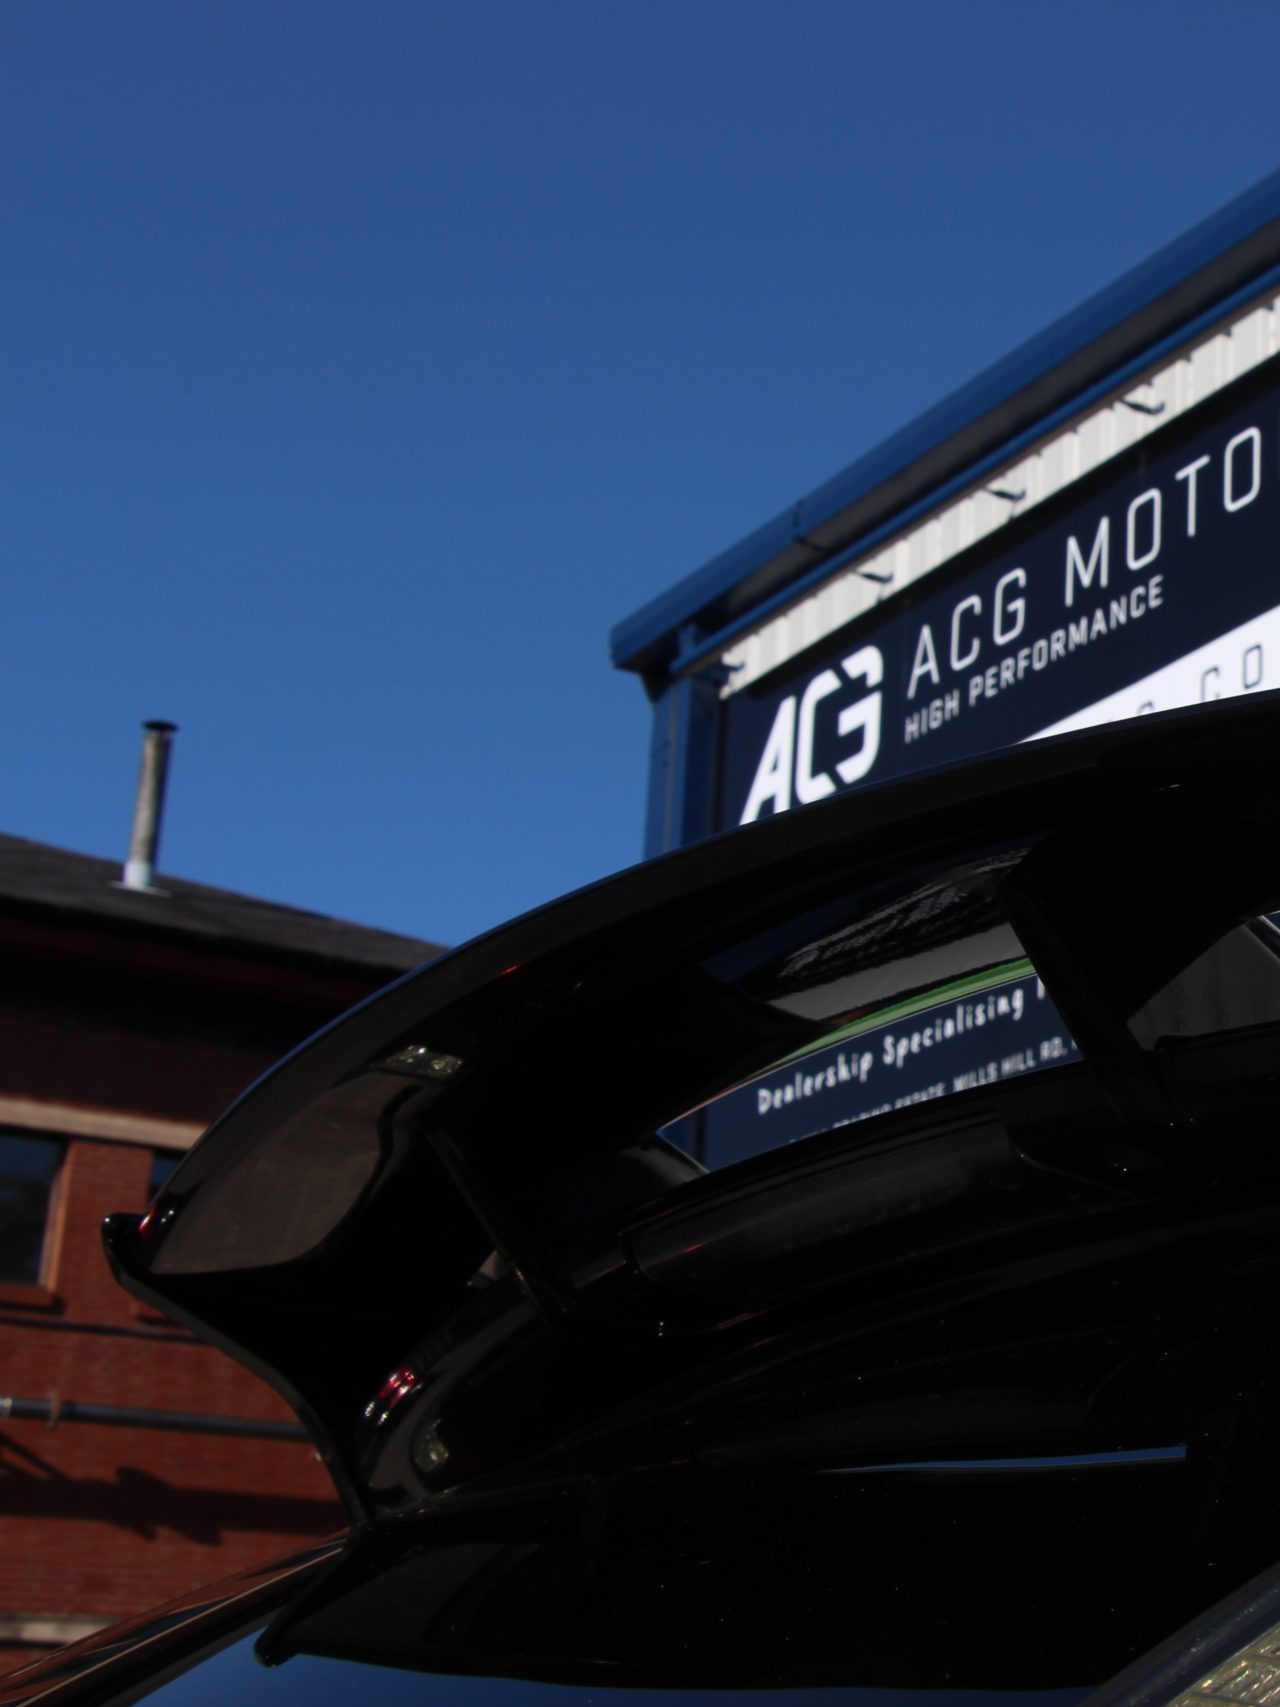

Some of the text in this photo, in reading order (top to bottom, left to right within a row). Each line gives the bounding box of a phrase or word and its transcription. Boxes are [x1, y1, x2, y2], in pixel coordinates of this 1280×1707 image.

[904, 574, 1164, 745] HIGH PERFORMANCE
[907, 568, 1027, 699] ACG
[739, 645, 883, 826] ACG
[756, 987, 1024, 1116] Dealership Specialising
[1001, 1048, 1036, 1077] HILL
